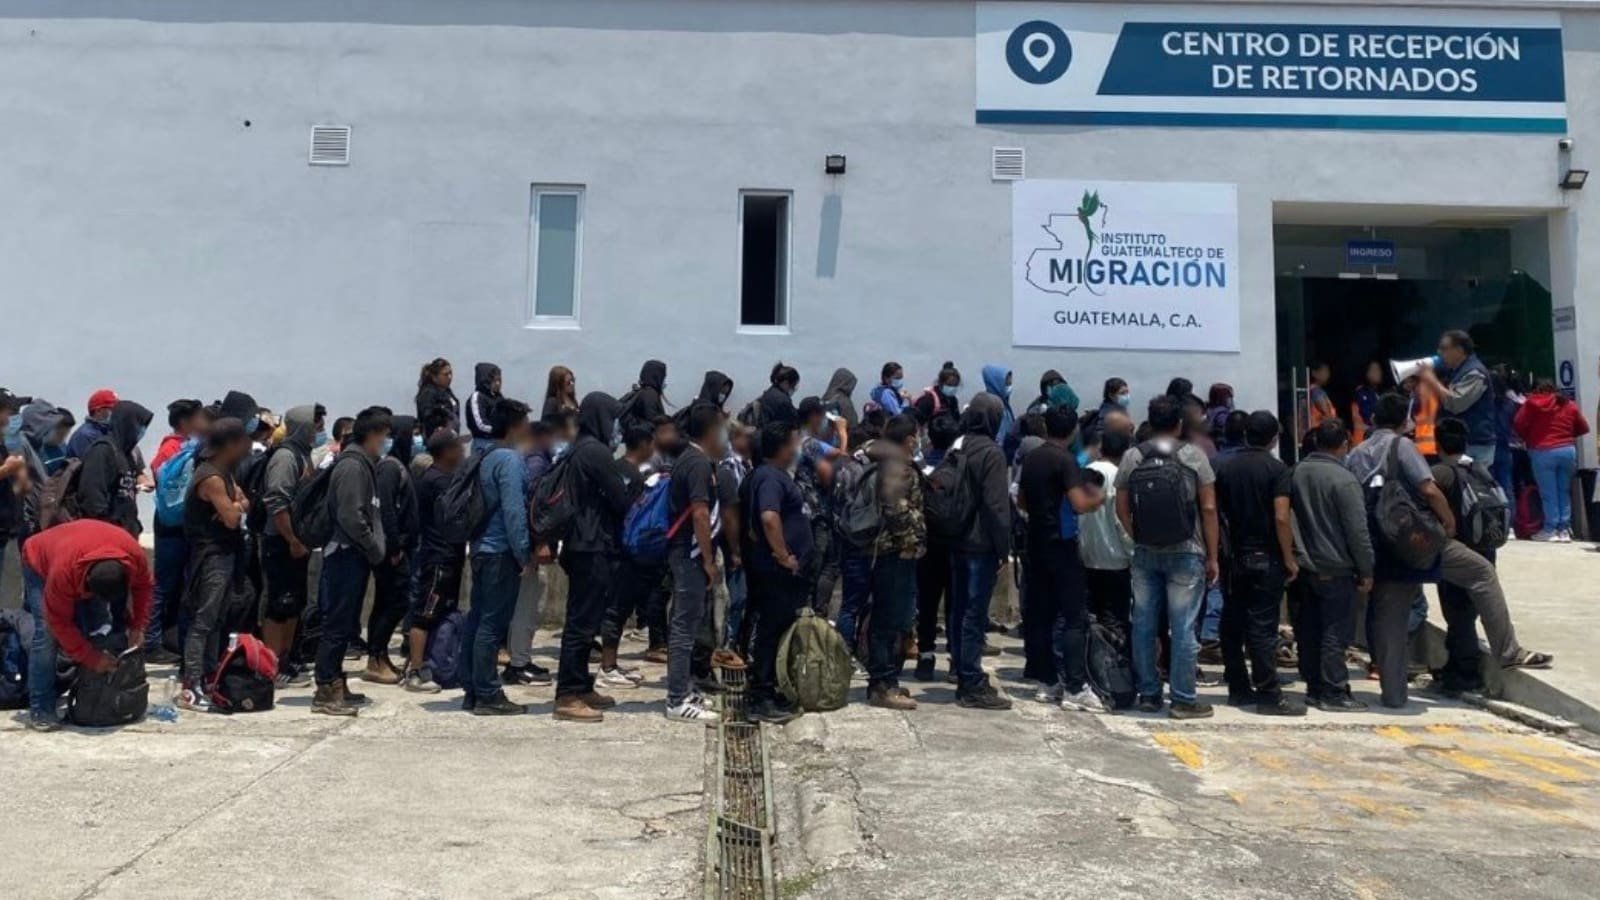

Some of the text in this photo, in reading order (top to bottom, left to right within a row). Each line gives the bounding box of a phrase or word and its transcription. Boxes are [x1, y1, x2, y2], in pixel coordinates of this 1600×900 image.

[1162, 31, 1520, 61] CENTRO DE RECEPCIÓN
[1212, 65, 1478, 93] DE RETORNADOS
[1101, 233, 1166, 245] INSTITUTO
[1101, 245, 1225, 259] GUATEMALTECO DE
[1350, 247, 1392, 257] INGRESO
[1050, 258, 1226, 288] MIGRACIÓN
[1054, 310, 1203, 329] GUATEMALA, C.A.
